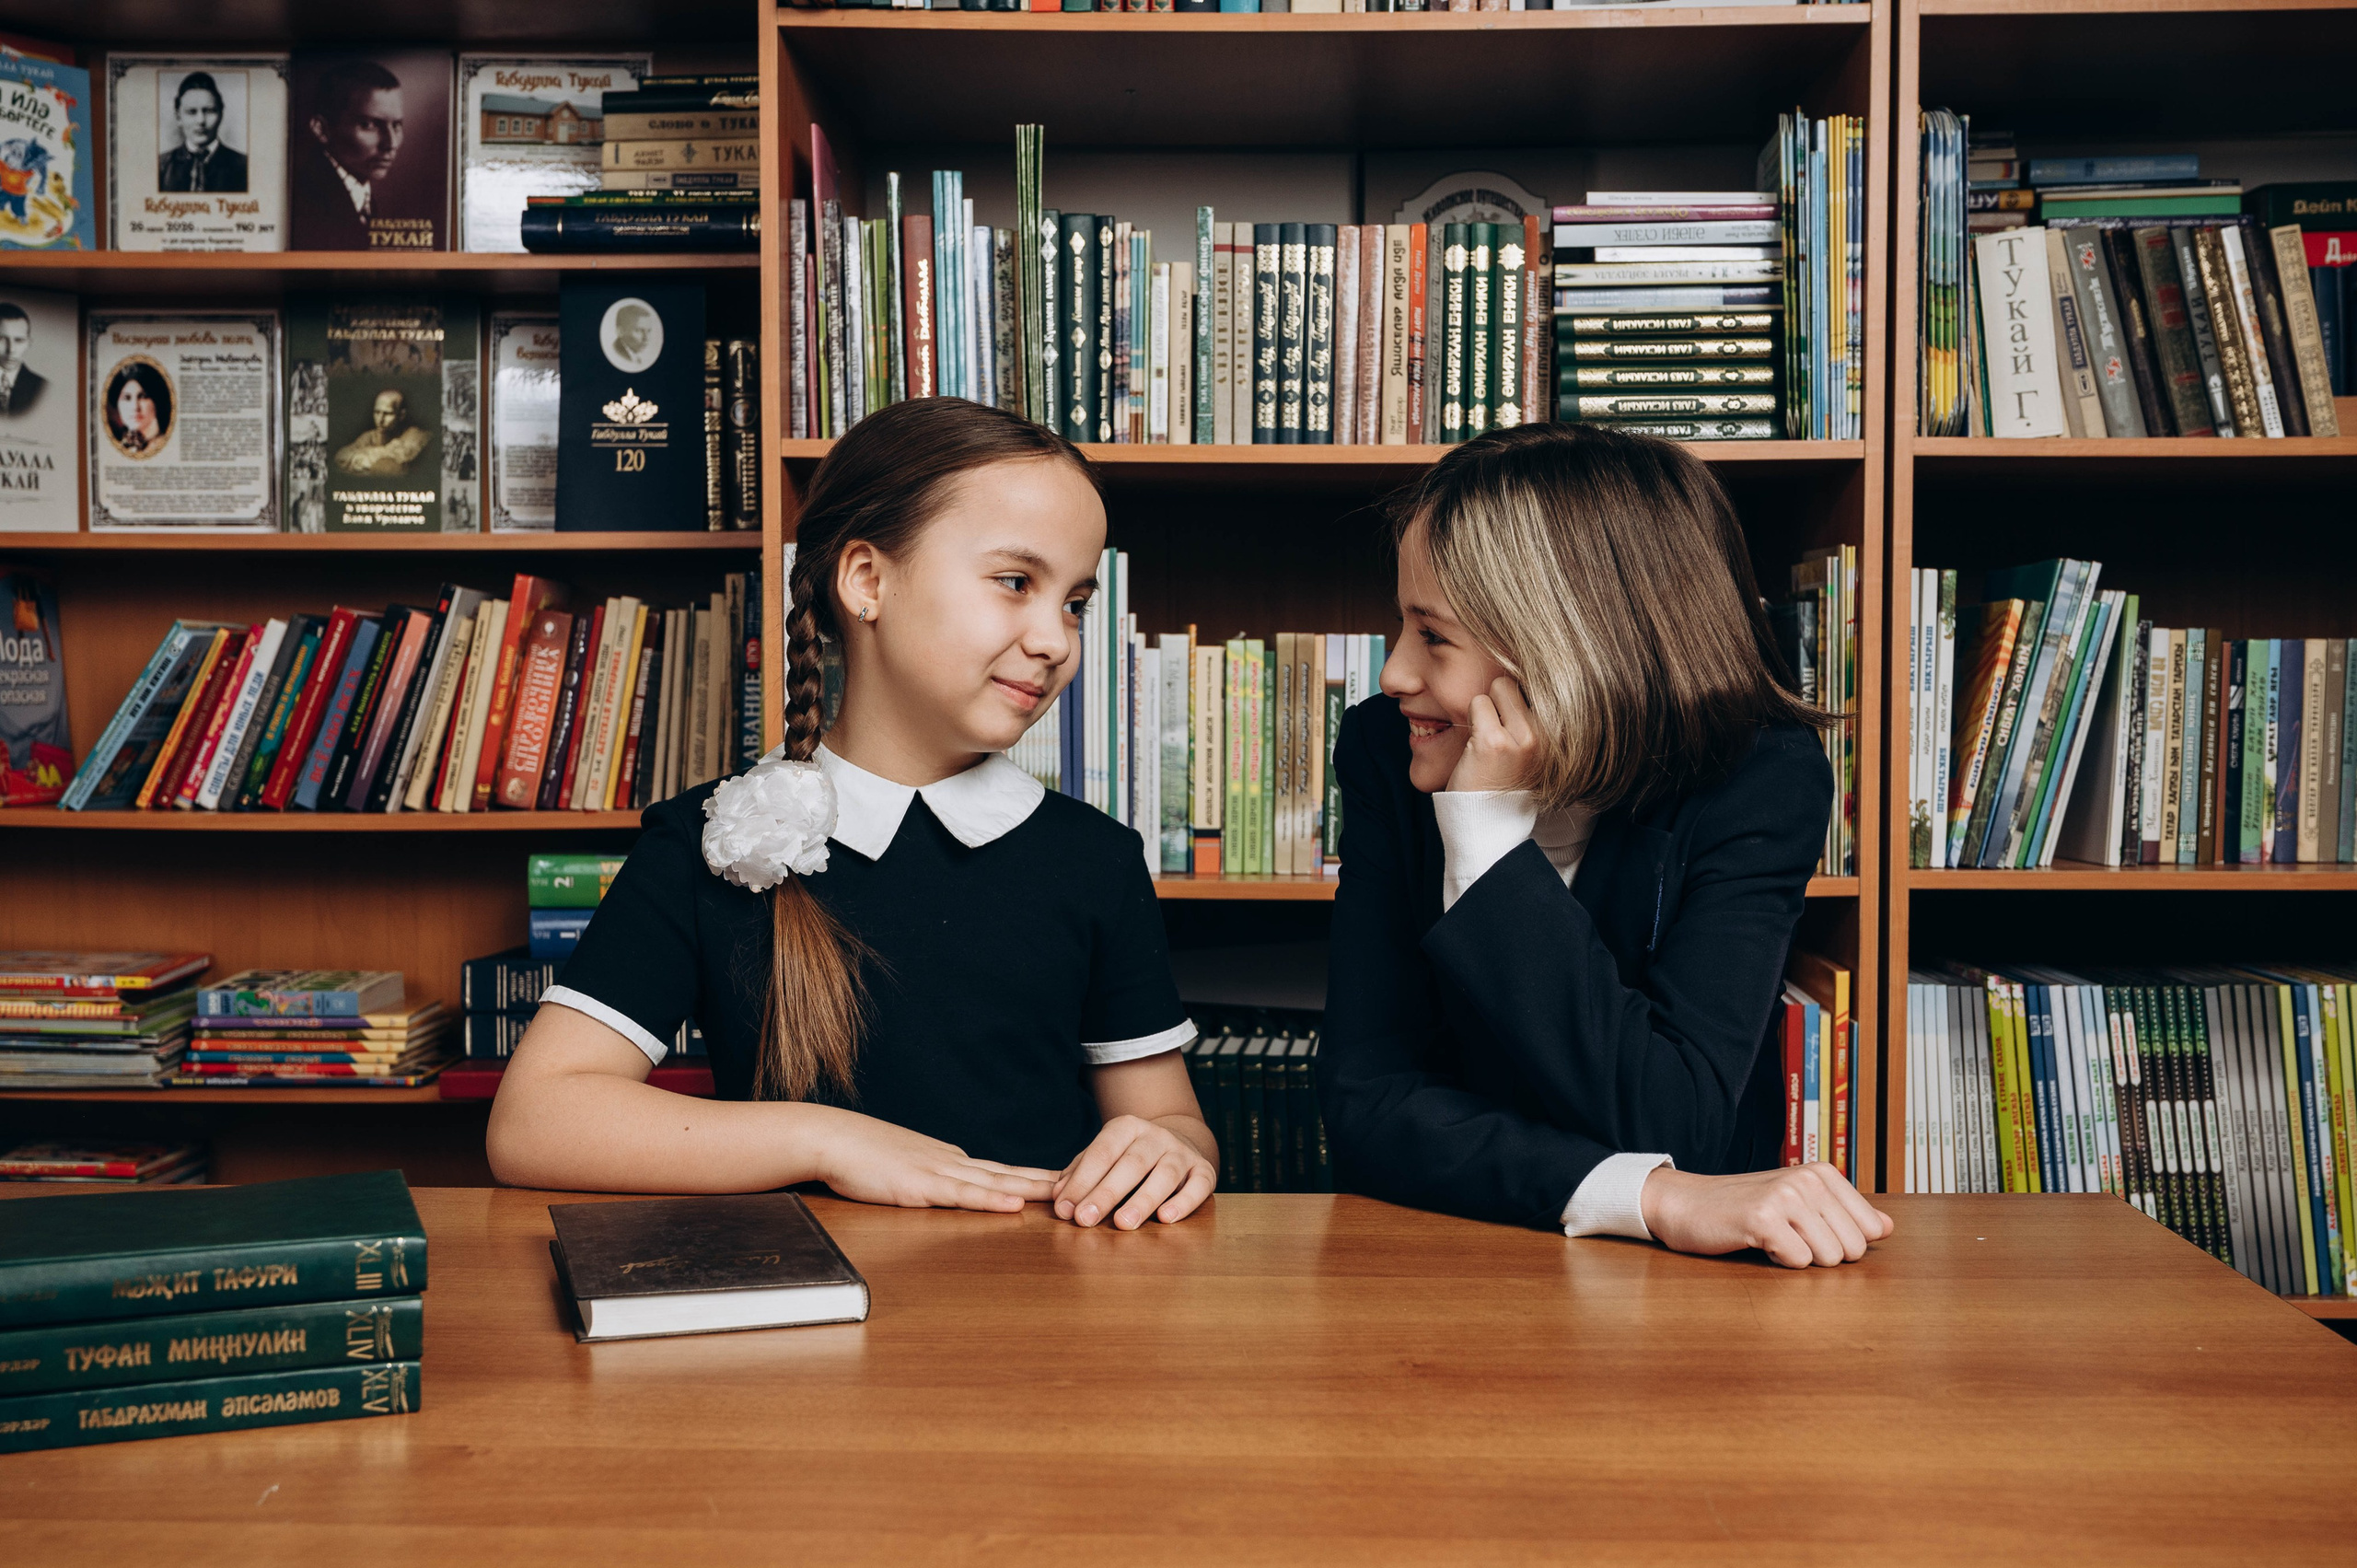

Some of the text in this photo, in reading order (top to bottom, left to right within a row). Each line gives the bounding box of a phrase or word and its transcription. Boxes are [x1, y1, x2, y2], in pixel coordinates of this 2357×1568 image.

[495, 71, 611, 92] Габдулла Тукай
[718, 117, 759, 131] ТУКА
[713, 145, 760, 163] ТУКА
[166, 221, 194, 232] 2026
[216, 198, 260, 219] Тукай
[368, 229, 433, 247] ТУКАЙ
[1613, 226, 1705, 241] ӘДӘБИ СҮЗЛЕК
[1198, 236, 1210, 276] фикер
[1447, 276, 1461, 396] ӘМИРХАН ЕНИКИ
[1473, 276, 1488, 399] ӘМИРХАН ЕНИКИ
[1501, 274, 1516, 397] ӘМИРХАН ЕНИКИ
[1538, 275, 1548, 377] ГЛУБОКИЕ КОРНИ
[1612, 319, 1691, 330] ГАЯЗ ИСХАКЫЙ
[2192, 296, 2213, 362] ТУКАЙ
[1613, 344, 1692, 354] ГАЯЗ ИСХАКЫЙ
[1616, 372, 1694, 382] ГАЯЗ ИСХАКЫЙ
[1618, 400, 1696, 411] ГАЯЗ ИСХАКЫЙ
[590, 427, 668, 443] Габдулла Тукай
[615, 449, 645, 471] 120
[2173, 643, 2184, 684] ТАРИХЫ
[335, 667, 363, 713] ВСЕХ
[512, 645, 549, 772] СПРАВОЧНИК
[524, 646, 561, 773] ШКОЛЬНИКА
[1994, 643, 2034, 748] СИБГАТ ХӘКИМ
[223, 732, 240, 756] ДЛЯ
[246, 669, 265, 698] ЛЕДИ
[743, 671, 761, 762] АВАНИЕ
[2170, 688, 2182, 740] ТАТАРСТАН
[1936, 747, 1946, 813] БИКТЫРЫШ
[2165, 811, 2175, 840] ТАТАР
[354, 1240, 383, 1290] XLIII
[345, 1305, 377, 1360] XLIV
[64, 1342, 151, 1372] ТУФАН
[221, 1388, 341, 1418] ӘПСӘЛӘМОВ
[361, 1365, 390, 1412] XLV
